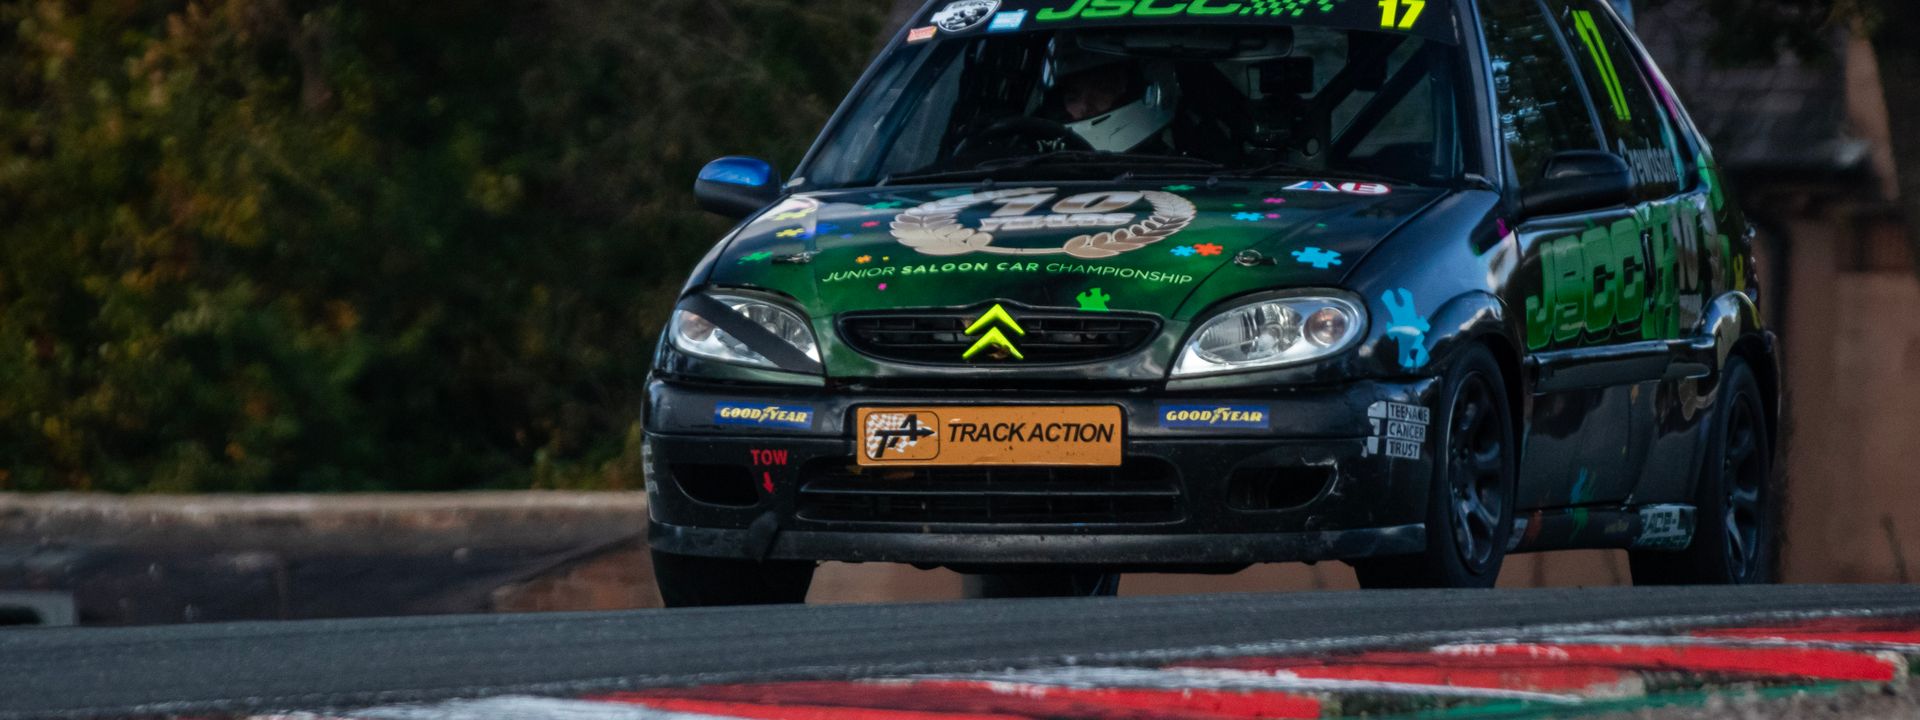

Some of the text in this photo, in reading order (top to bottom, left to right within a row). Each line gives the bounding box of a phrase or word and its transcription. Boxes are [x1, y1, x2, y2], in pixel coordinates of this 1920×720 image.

[1378, 0, 1425, 28] 17
[1571, 9, 1632, 121] 17
[822, 262, 1193, 284] JUNIOR SALOON CAR CHAMPIONSHIP
[720, 406, 808, 422] GOODYEAR
[1166, 407, 1263, 424] GOODYEAR
[1390, 403, 1428, 423] TEENAGE
[947, 422, 1115, 443] TRACK ACTION
[1390, 422, 1425, 440] CANCER
[750, 448, 788, 466] TOW
[1389, 441, 1418, 457] TRUST
